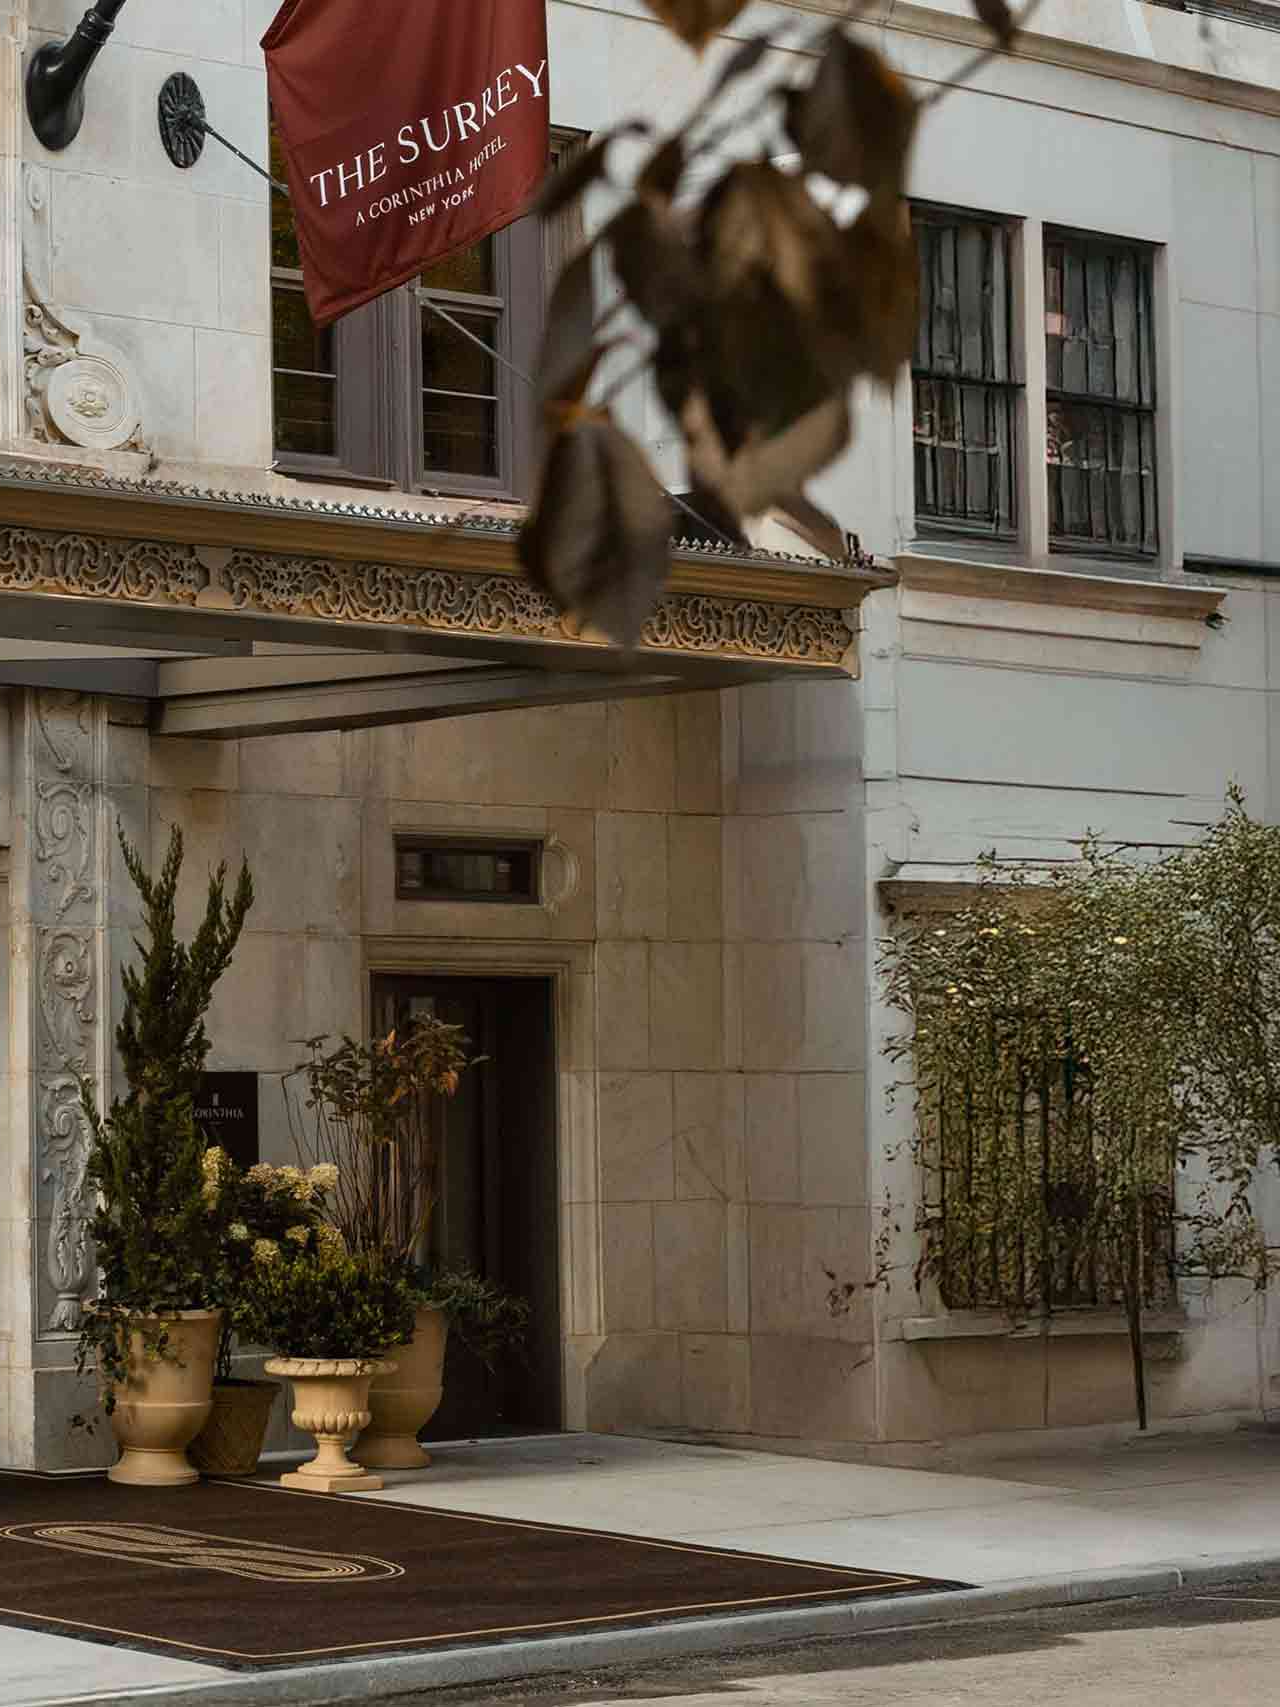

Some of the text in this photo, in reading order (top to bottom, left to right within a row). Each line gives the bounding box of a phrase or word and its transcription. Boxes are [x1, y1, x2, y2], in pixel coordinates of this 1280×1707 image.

[310, 59, 547, 208] THE SURREY
[355, 135, 507, 227] A CORINTHIA HOTEL
[408, 184, 475, 226] NEW YORK
